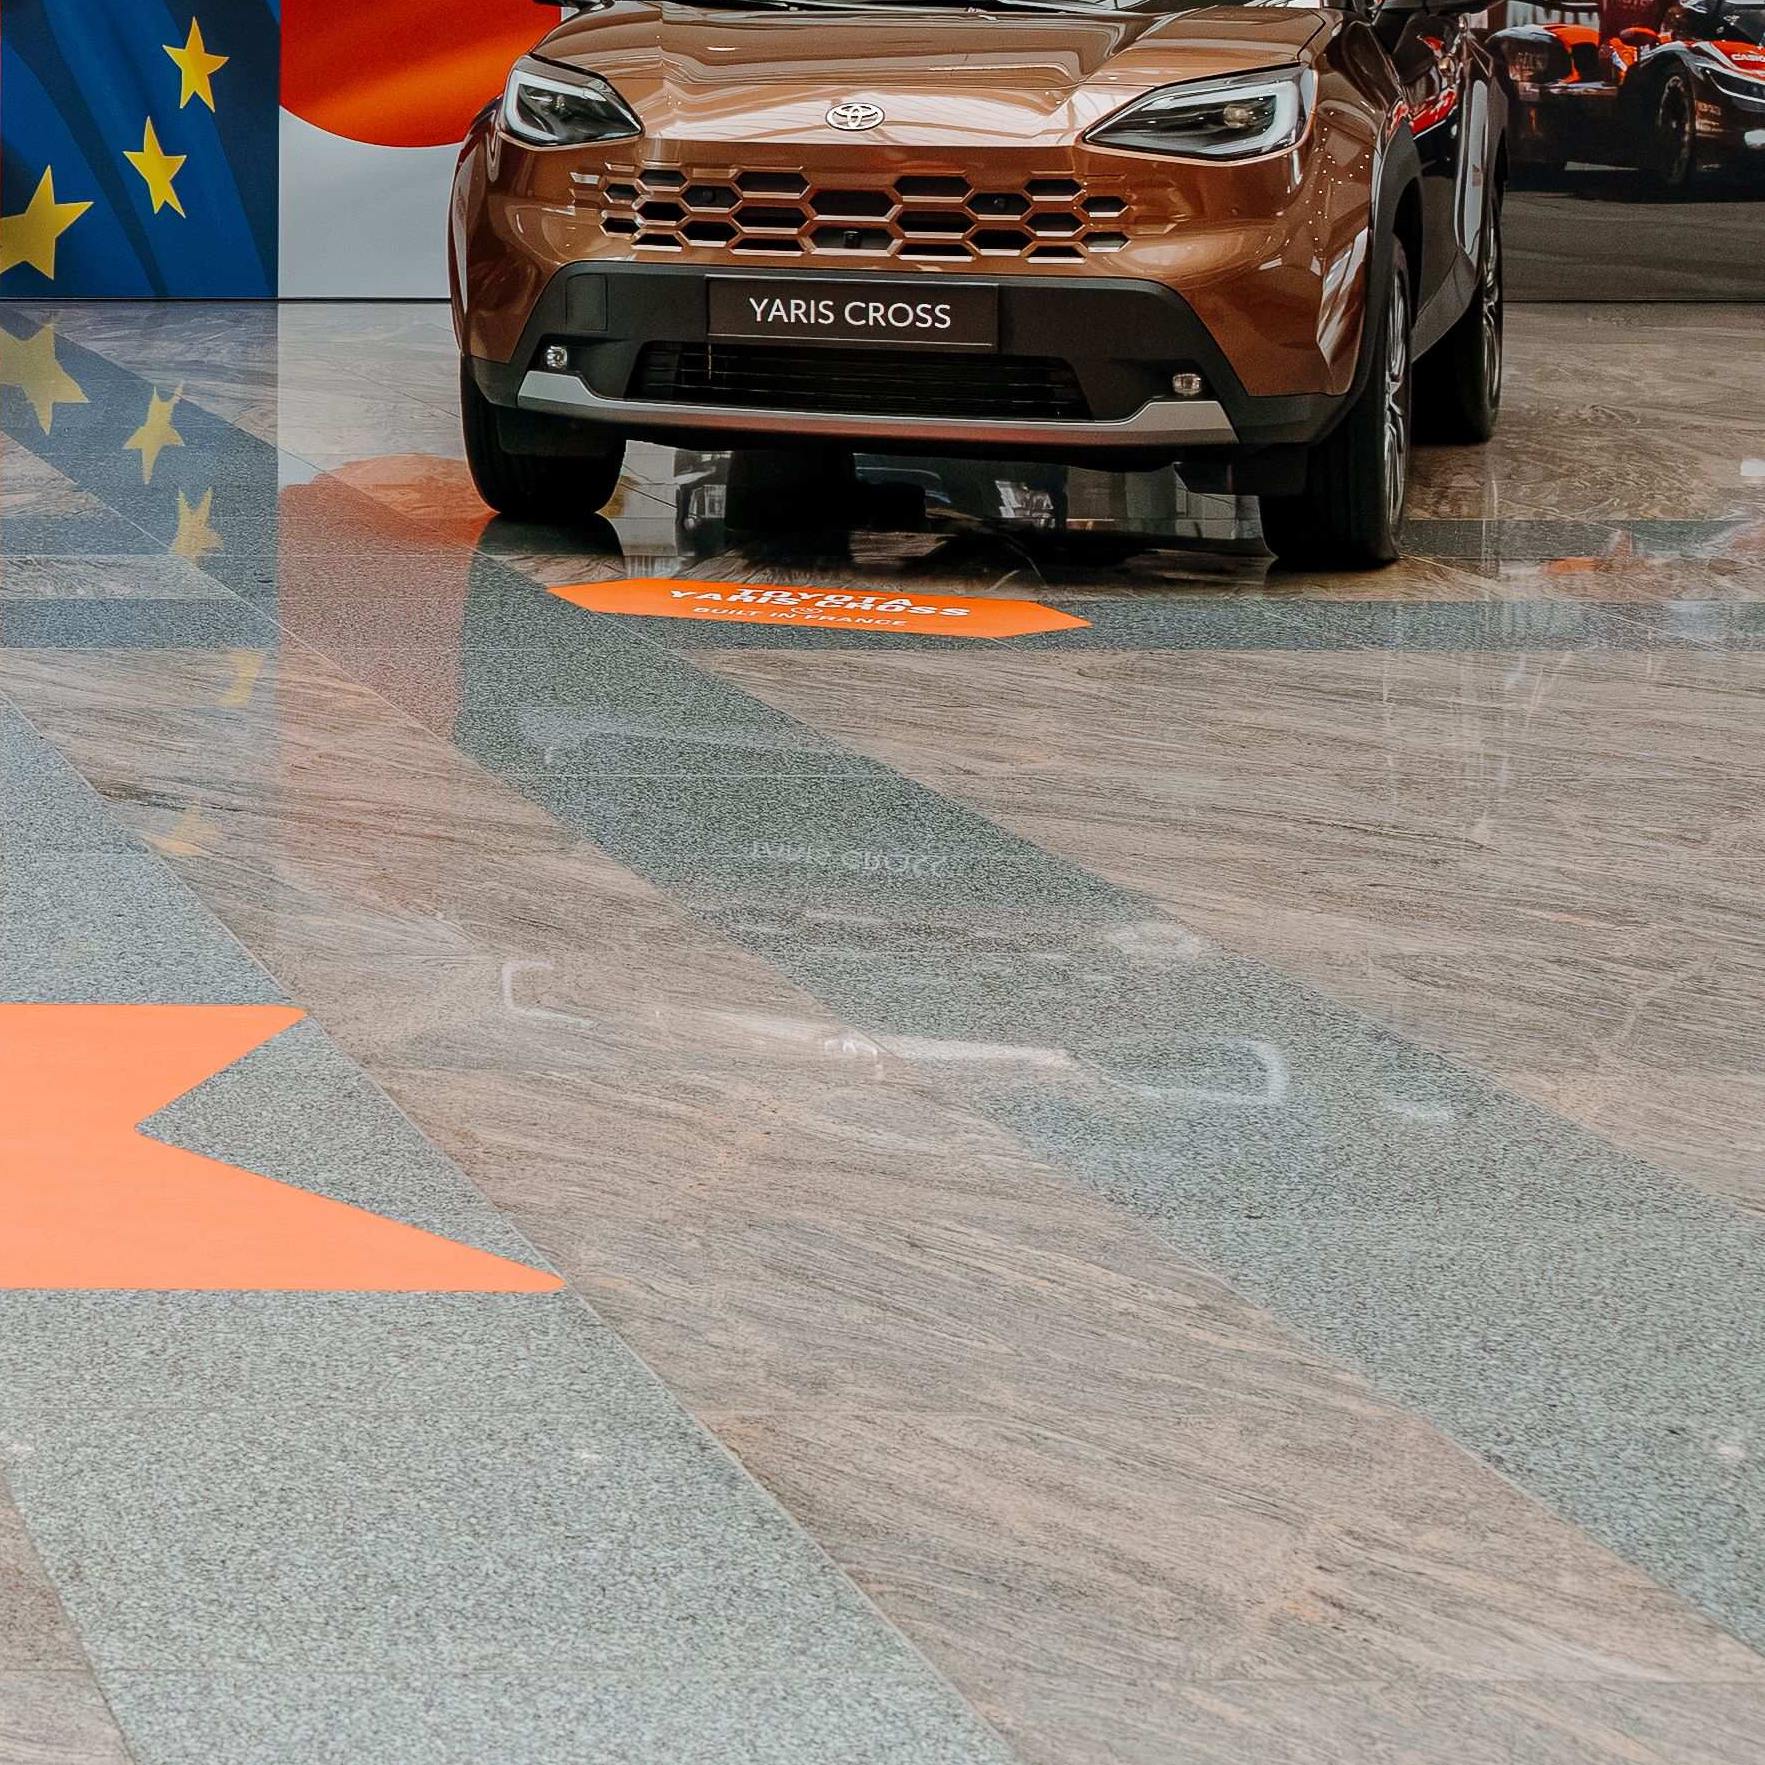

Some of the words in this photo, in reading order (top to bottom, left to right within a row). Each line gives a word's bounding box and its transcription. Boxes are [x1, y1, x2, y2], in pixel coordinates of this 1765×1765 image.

[749, 298, 835, 324] YARIS
[844, 302, 951, 328] CROSS
[670, 590, 802, 605] YARIS
[815, 600, 971, 616] CROSS
[731, 588, 914, 606] TOYOTA
[693, 607, 761, 617] BUILT
[770, 611, 797, 619] IN
[804, 614, 909, 626] FRANCE
